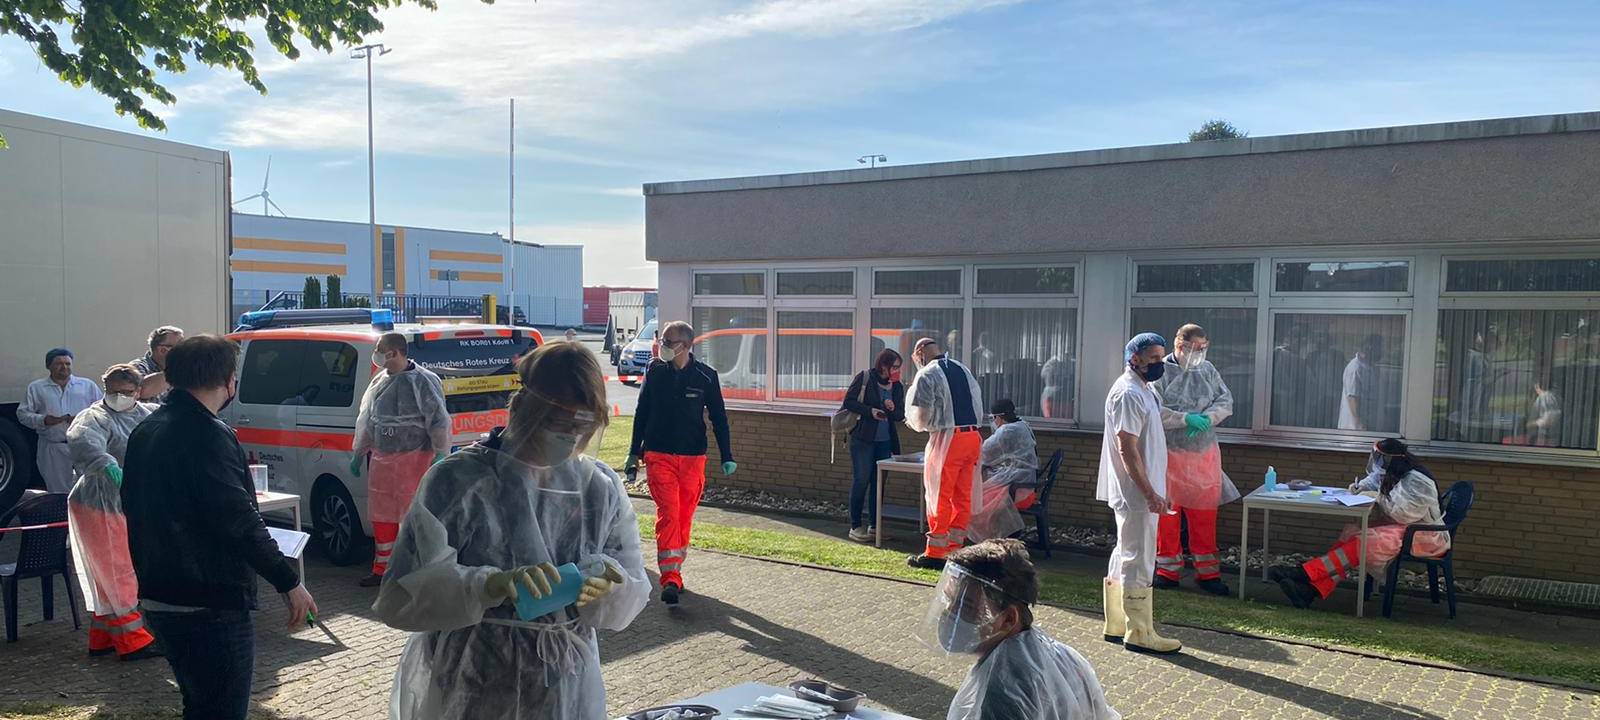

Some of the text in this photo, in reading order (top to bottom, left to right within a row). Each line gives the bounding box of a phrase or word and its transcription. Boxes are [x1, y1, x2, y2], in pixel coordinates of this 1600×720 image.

[421, 356, 510, 368] Deutsches Rotes Kreuz
